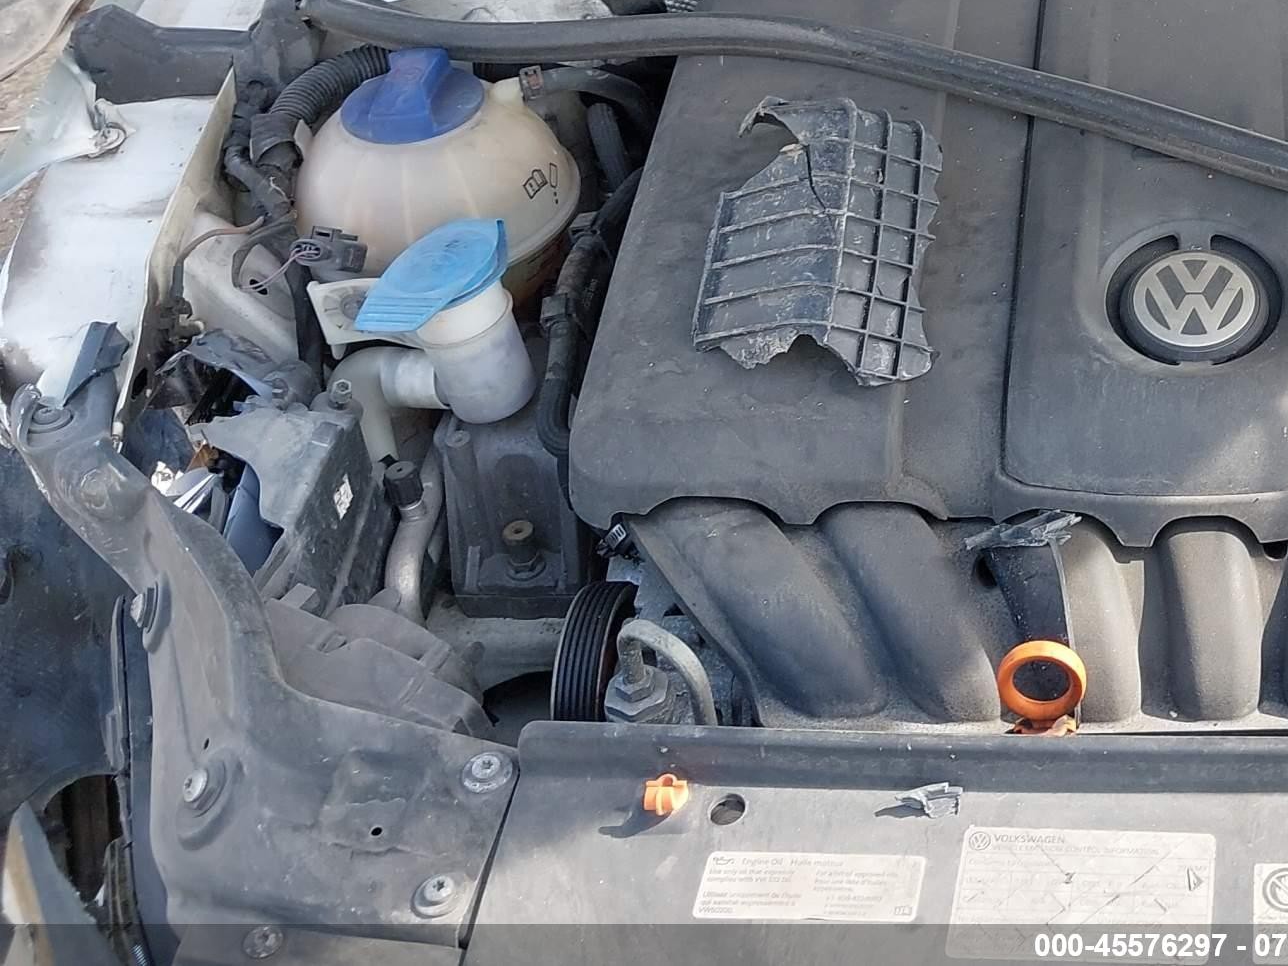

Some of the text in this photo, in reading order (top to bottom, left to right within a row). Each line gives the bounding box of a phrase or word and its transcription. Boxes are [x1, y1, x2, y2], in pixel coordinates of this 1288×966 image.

[993, 833, 1065, 844] VOLKSWAGEN
[741, 857, 769, 867] Engine
[770, 857, 784, 866] Oil
